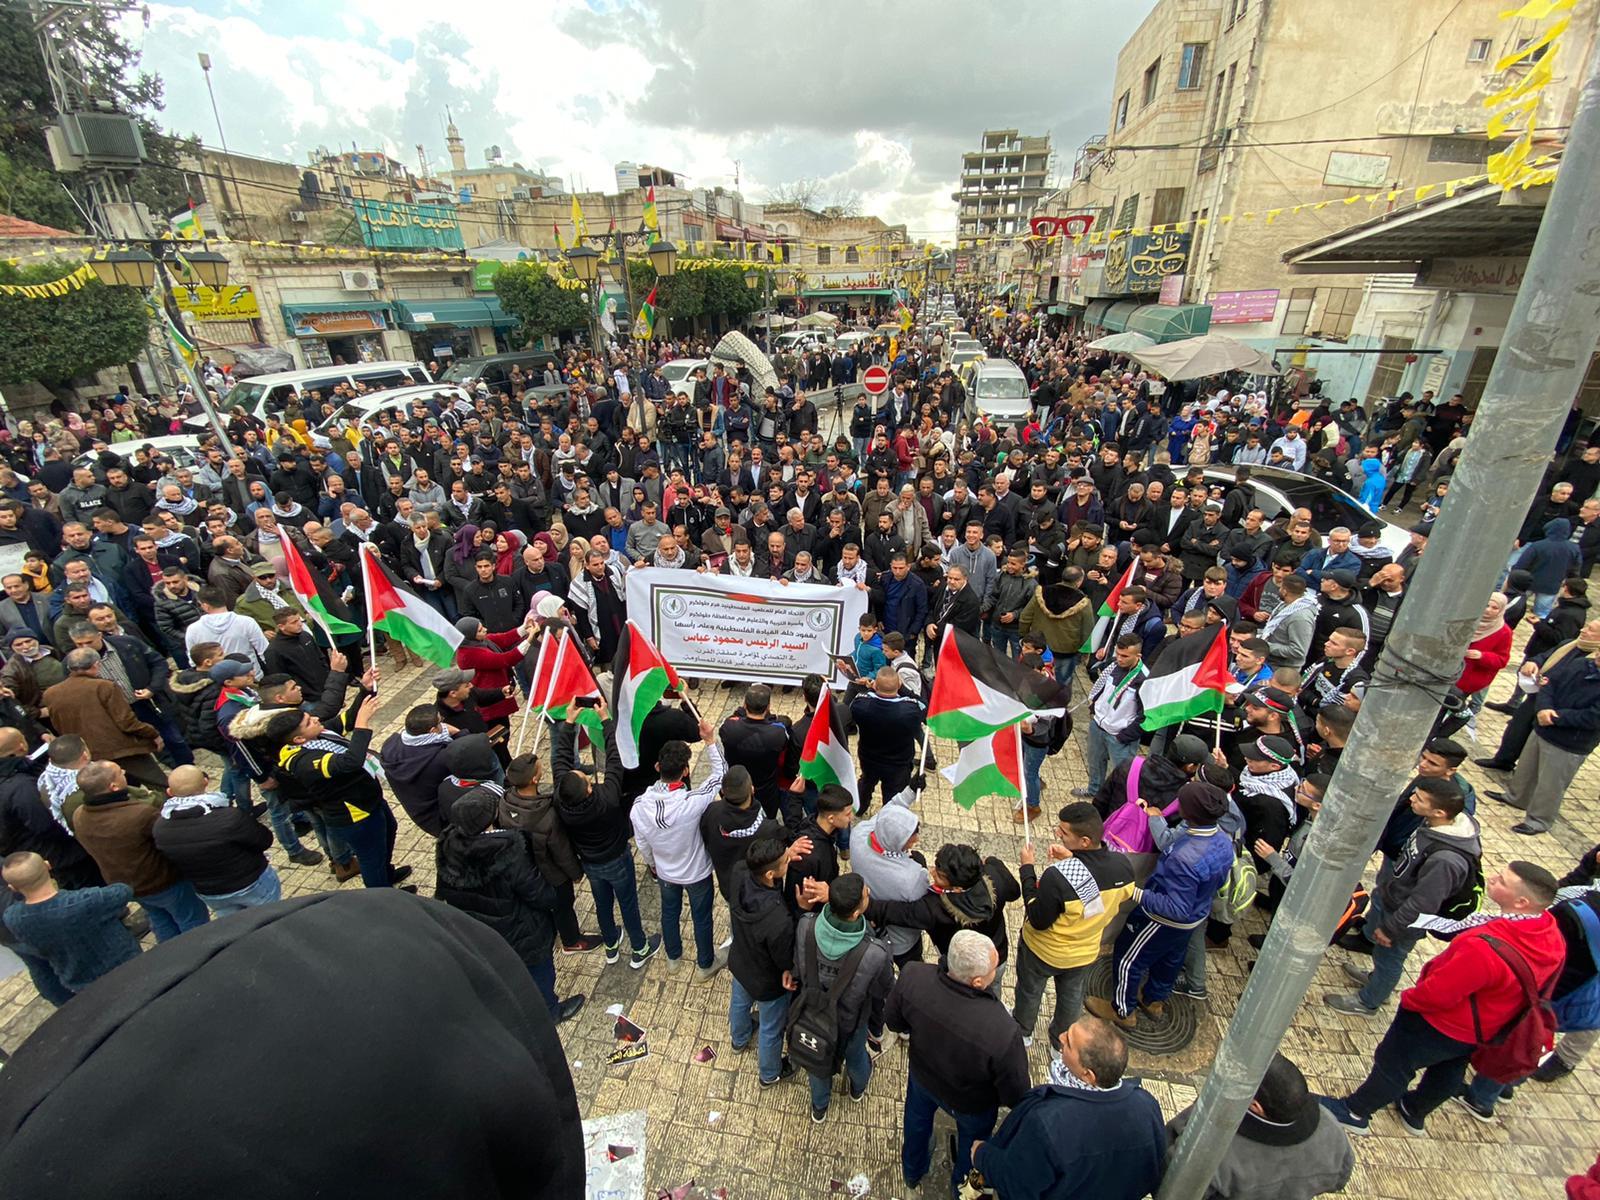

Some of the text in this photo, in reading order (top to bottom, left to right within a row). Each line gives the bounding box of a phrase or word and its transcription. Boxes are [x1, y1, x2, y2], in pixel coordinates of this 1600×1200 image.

[1139, 234, 1180, 255] ظافر
[80, 499, 102, 508] BLACK
[715, 624, 755, 635] الفلسطينية
[756, 627, 779, 636] القيادة
[683, 632, 809, 653] السيد الرئيس محمود عباس
[716, 648, 738, 656] صفقة
[739, 650, 760, 659] لمؤامرة
[761, 653, 788, 661] التصدي
